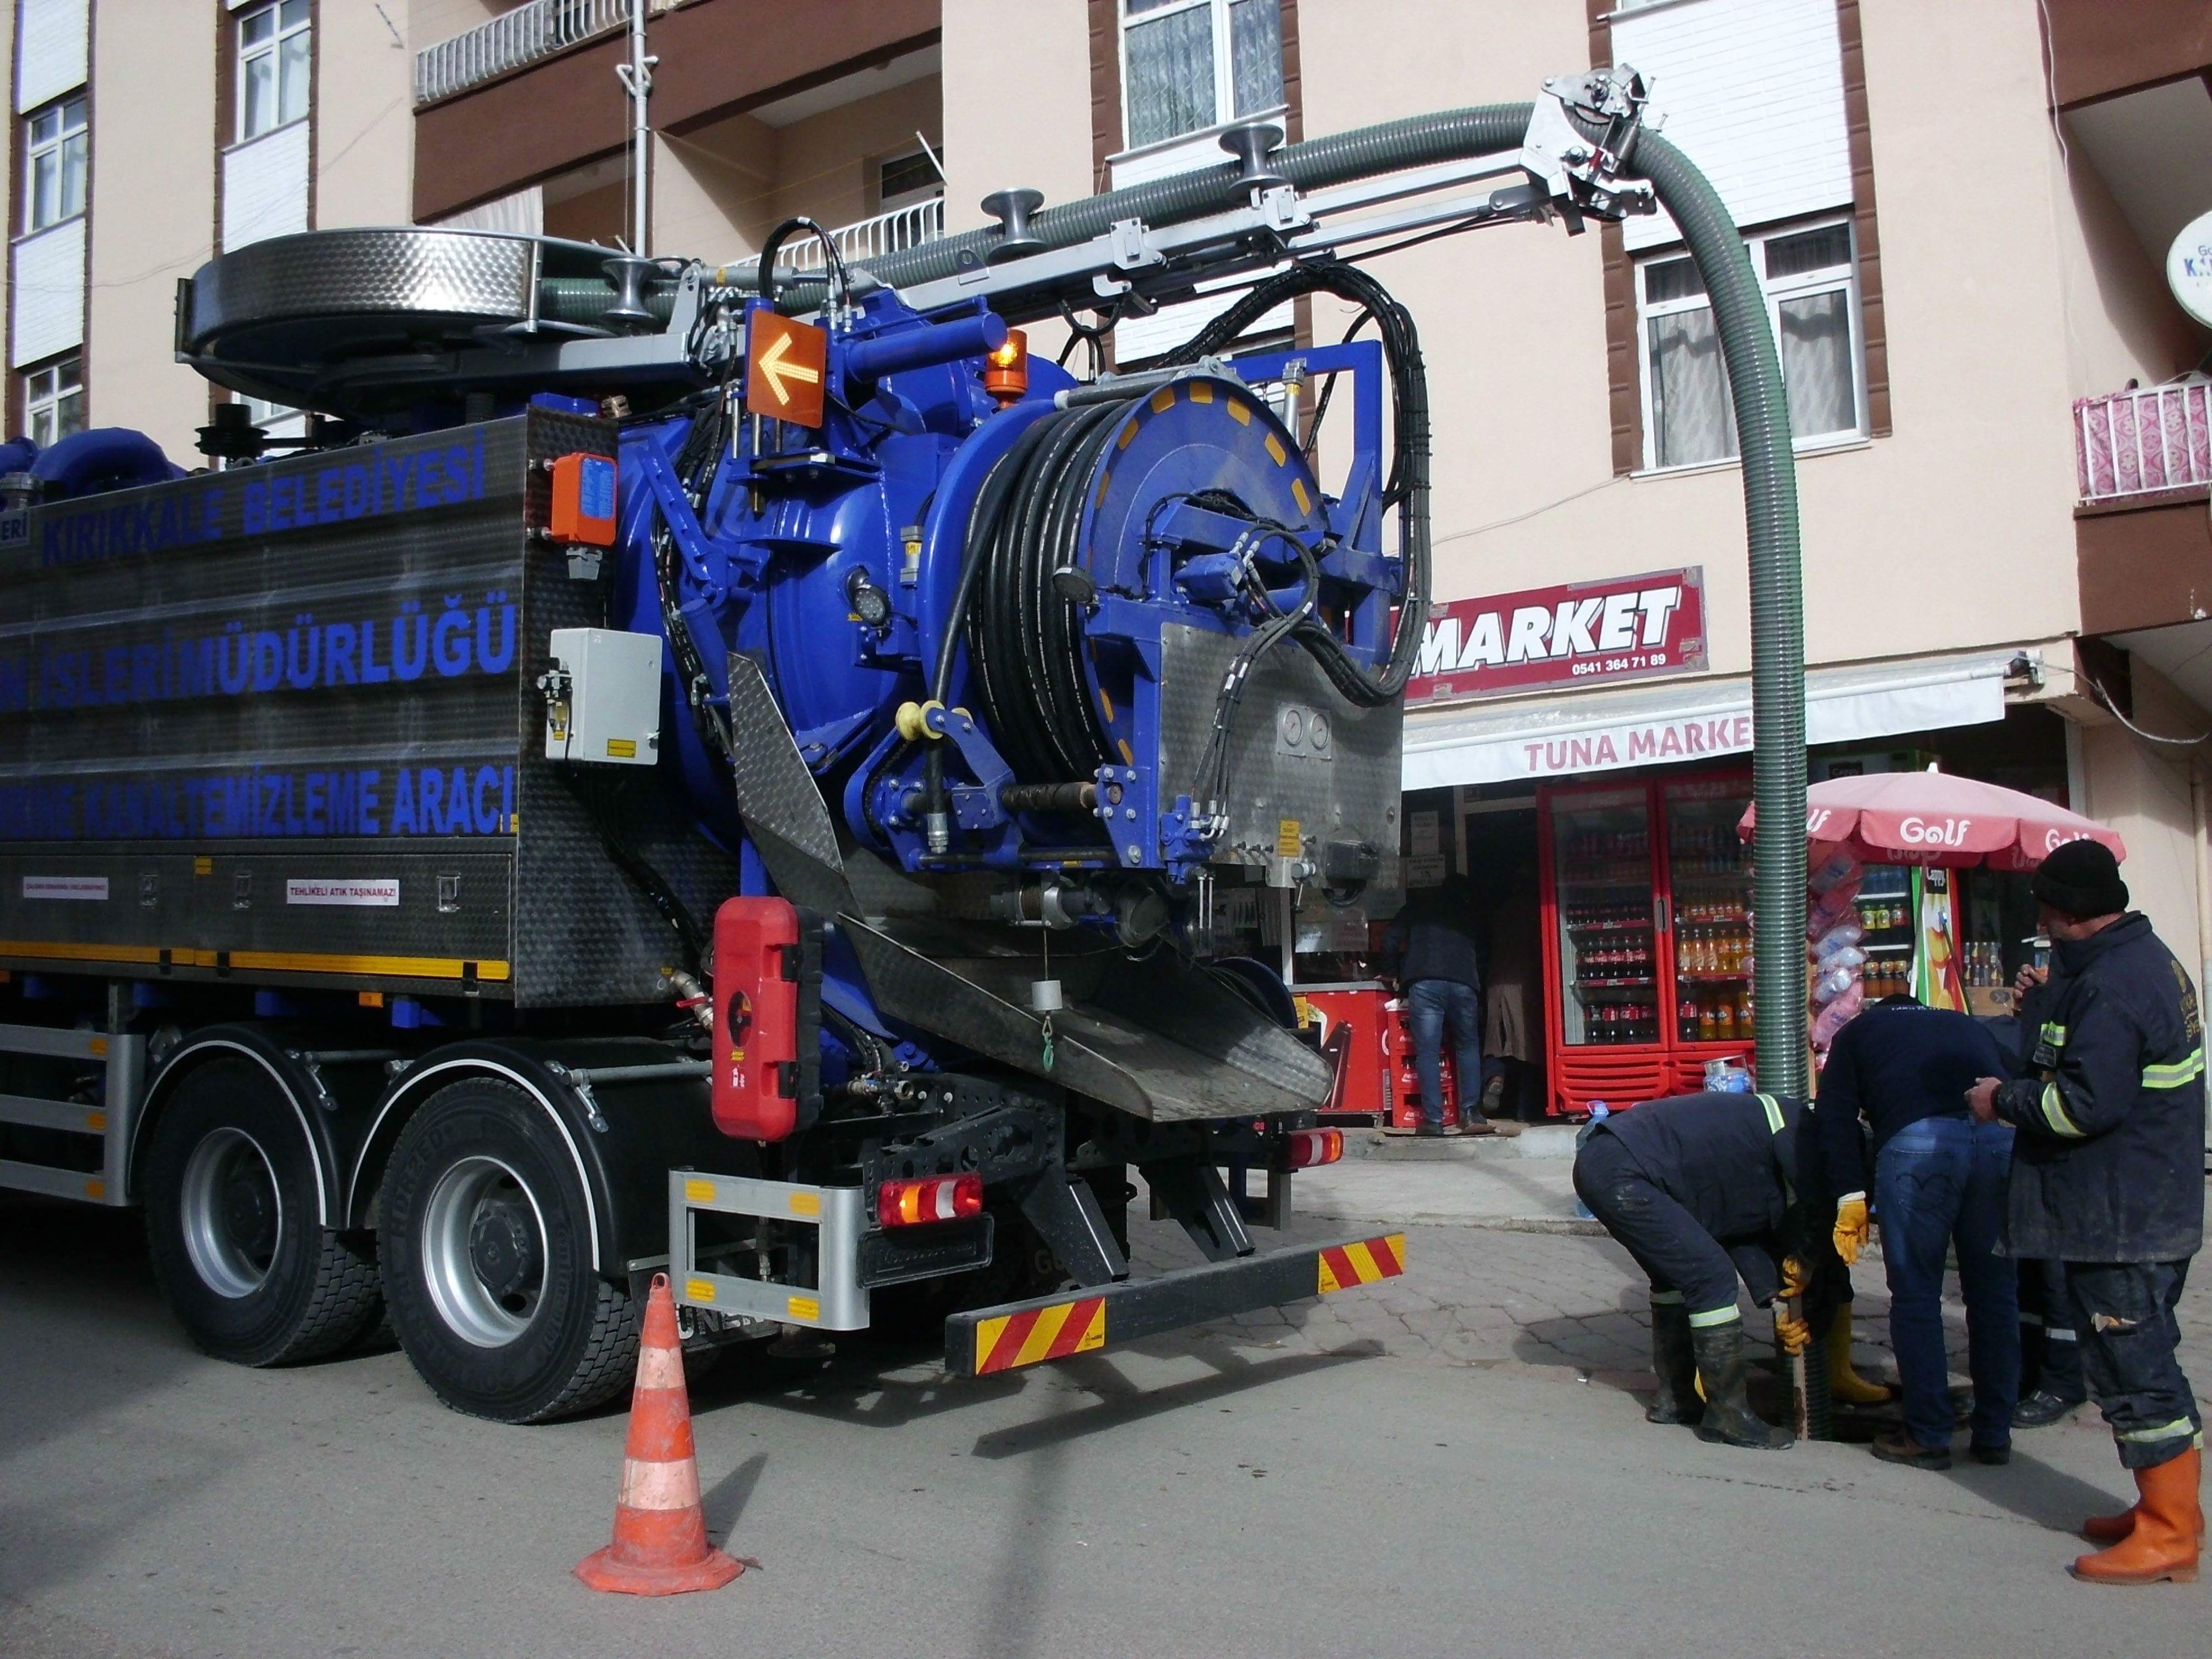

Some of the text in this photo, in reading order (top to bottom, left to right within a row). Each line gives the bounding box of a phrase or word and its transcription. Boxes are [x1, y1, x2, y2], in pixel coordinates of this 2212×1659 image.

[42, 494, 225, 567] KIRIKKALE
[243, 429, 484, 535] BELEDİYESİ
[179, 591, 516, 697] MÜDÜRLÜĞÜ
[1411, 585, 1682, 676] MARKET
[1572, 653, 1667, 675] 0541 364 71 89
[1524, 734, 1618, 771] TUNA
[183, 762, 381, 837] TEMİZLEME
[391, 764, 514, 836] ARACI
[1900, 817, 1971, 847] Golf
[290, 885, 327, 896] TEHLİKELİ
[330, 888, 347, 896] ATIK
